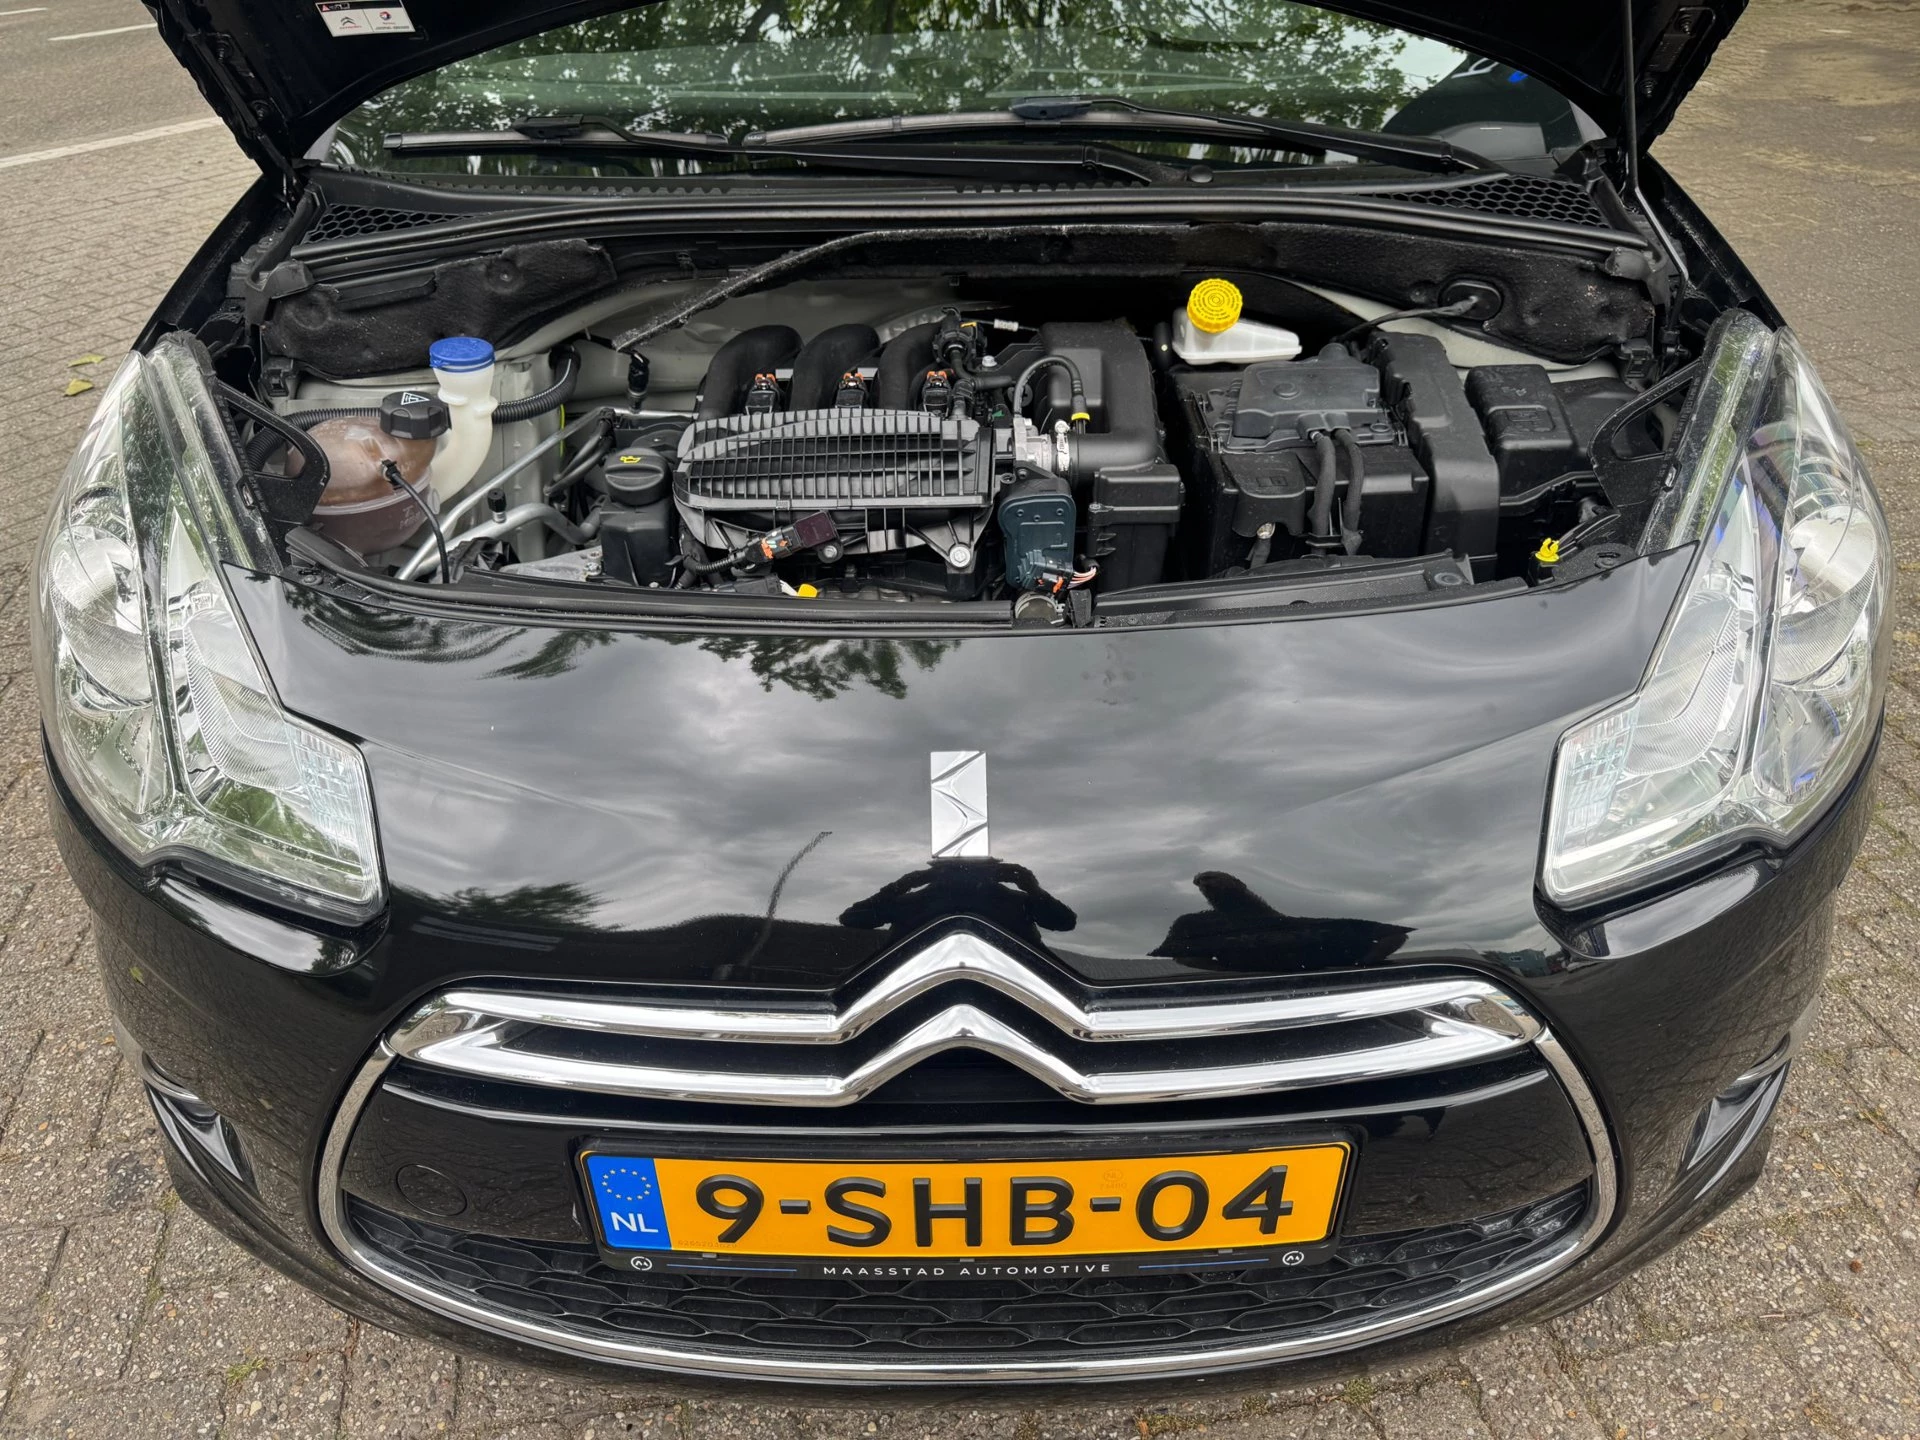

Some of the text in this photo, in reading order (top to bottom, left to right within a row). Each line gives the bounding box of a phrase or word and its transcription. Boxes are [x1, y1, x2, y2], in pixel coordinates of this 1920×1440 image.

[695, 1164, 1294, 1247] 9-SHB-04
[610, 1211, 659, 1233] NL
[823, 1263, 1111, 1277] MAASSTAD AUTOMOTIVE
